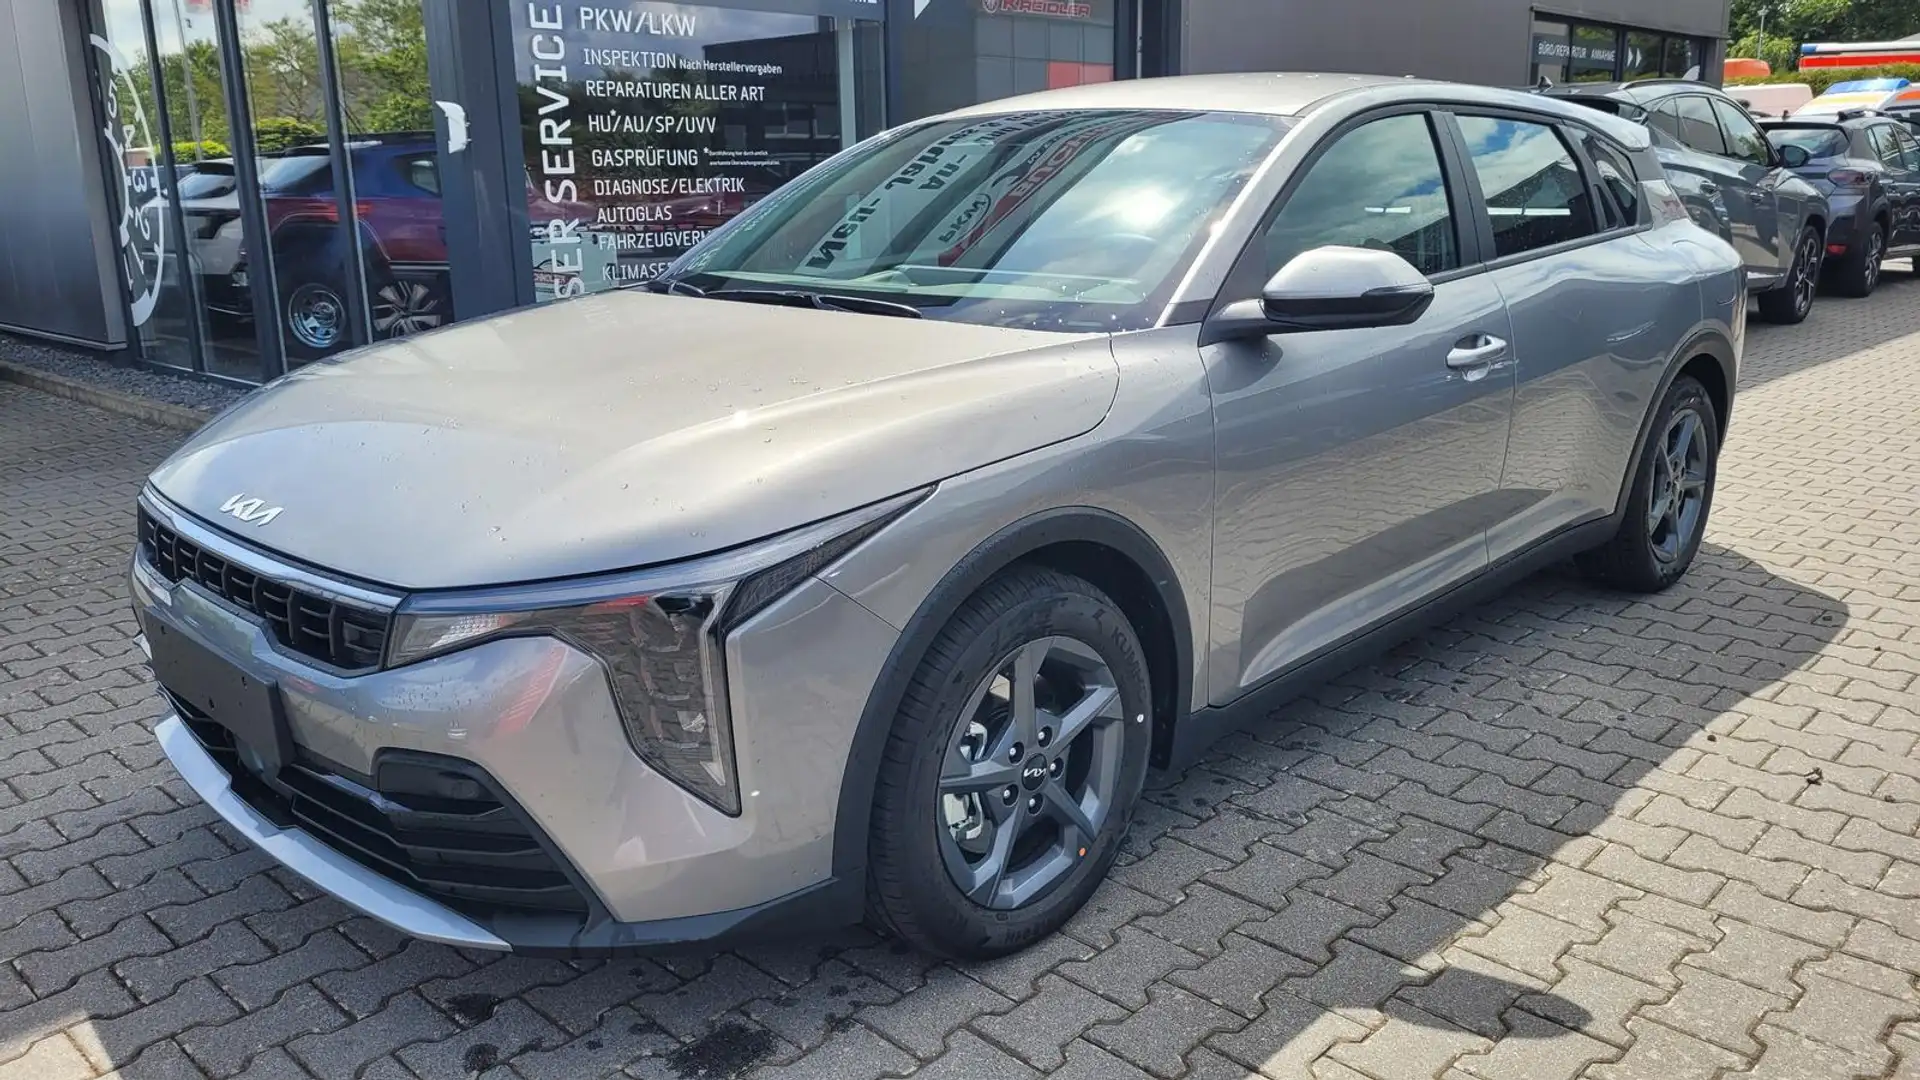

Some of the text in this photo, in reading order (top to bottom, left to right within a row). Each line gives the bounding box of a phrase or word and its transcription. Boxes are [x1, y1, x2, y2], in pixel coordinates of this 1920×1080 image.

[1001, 0, 1091, 17] KREIDLER
[579, 6, 697, 37] PKW/LKW
[583, 48, 783, 76] INSPEKTION Nach Herstellervorgaben
[585, 80, 765, 101] REPARATUREN ALLER ART
[528, 2, 578, 203] SERVICE
[591, 146, 699, 167] GASPRÜFUNG
[594, 177, 746, 196] DIAGNOSE/ELEKTRIK
[597, 205, 673, 223] AUTOGLAS
[602, 261, 672, 280] KLIMASE
